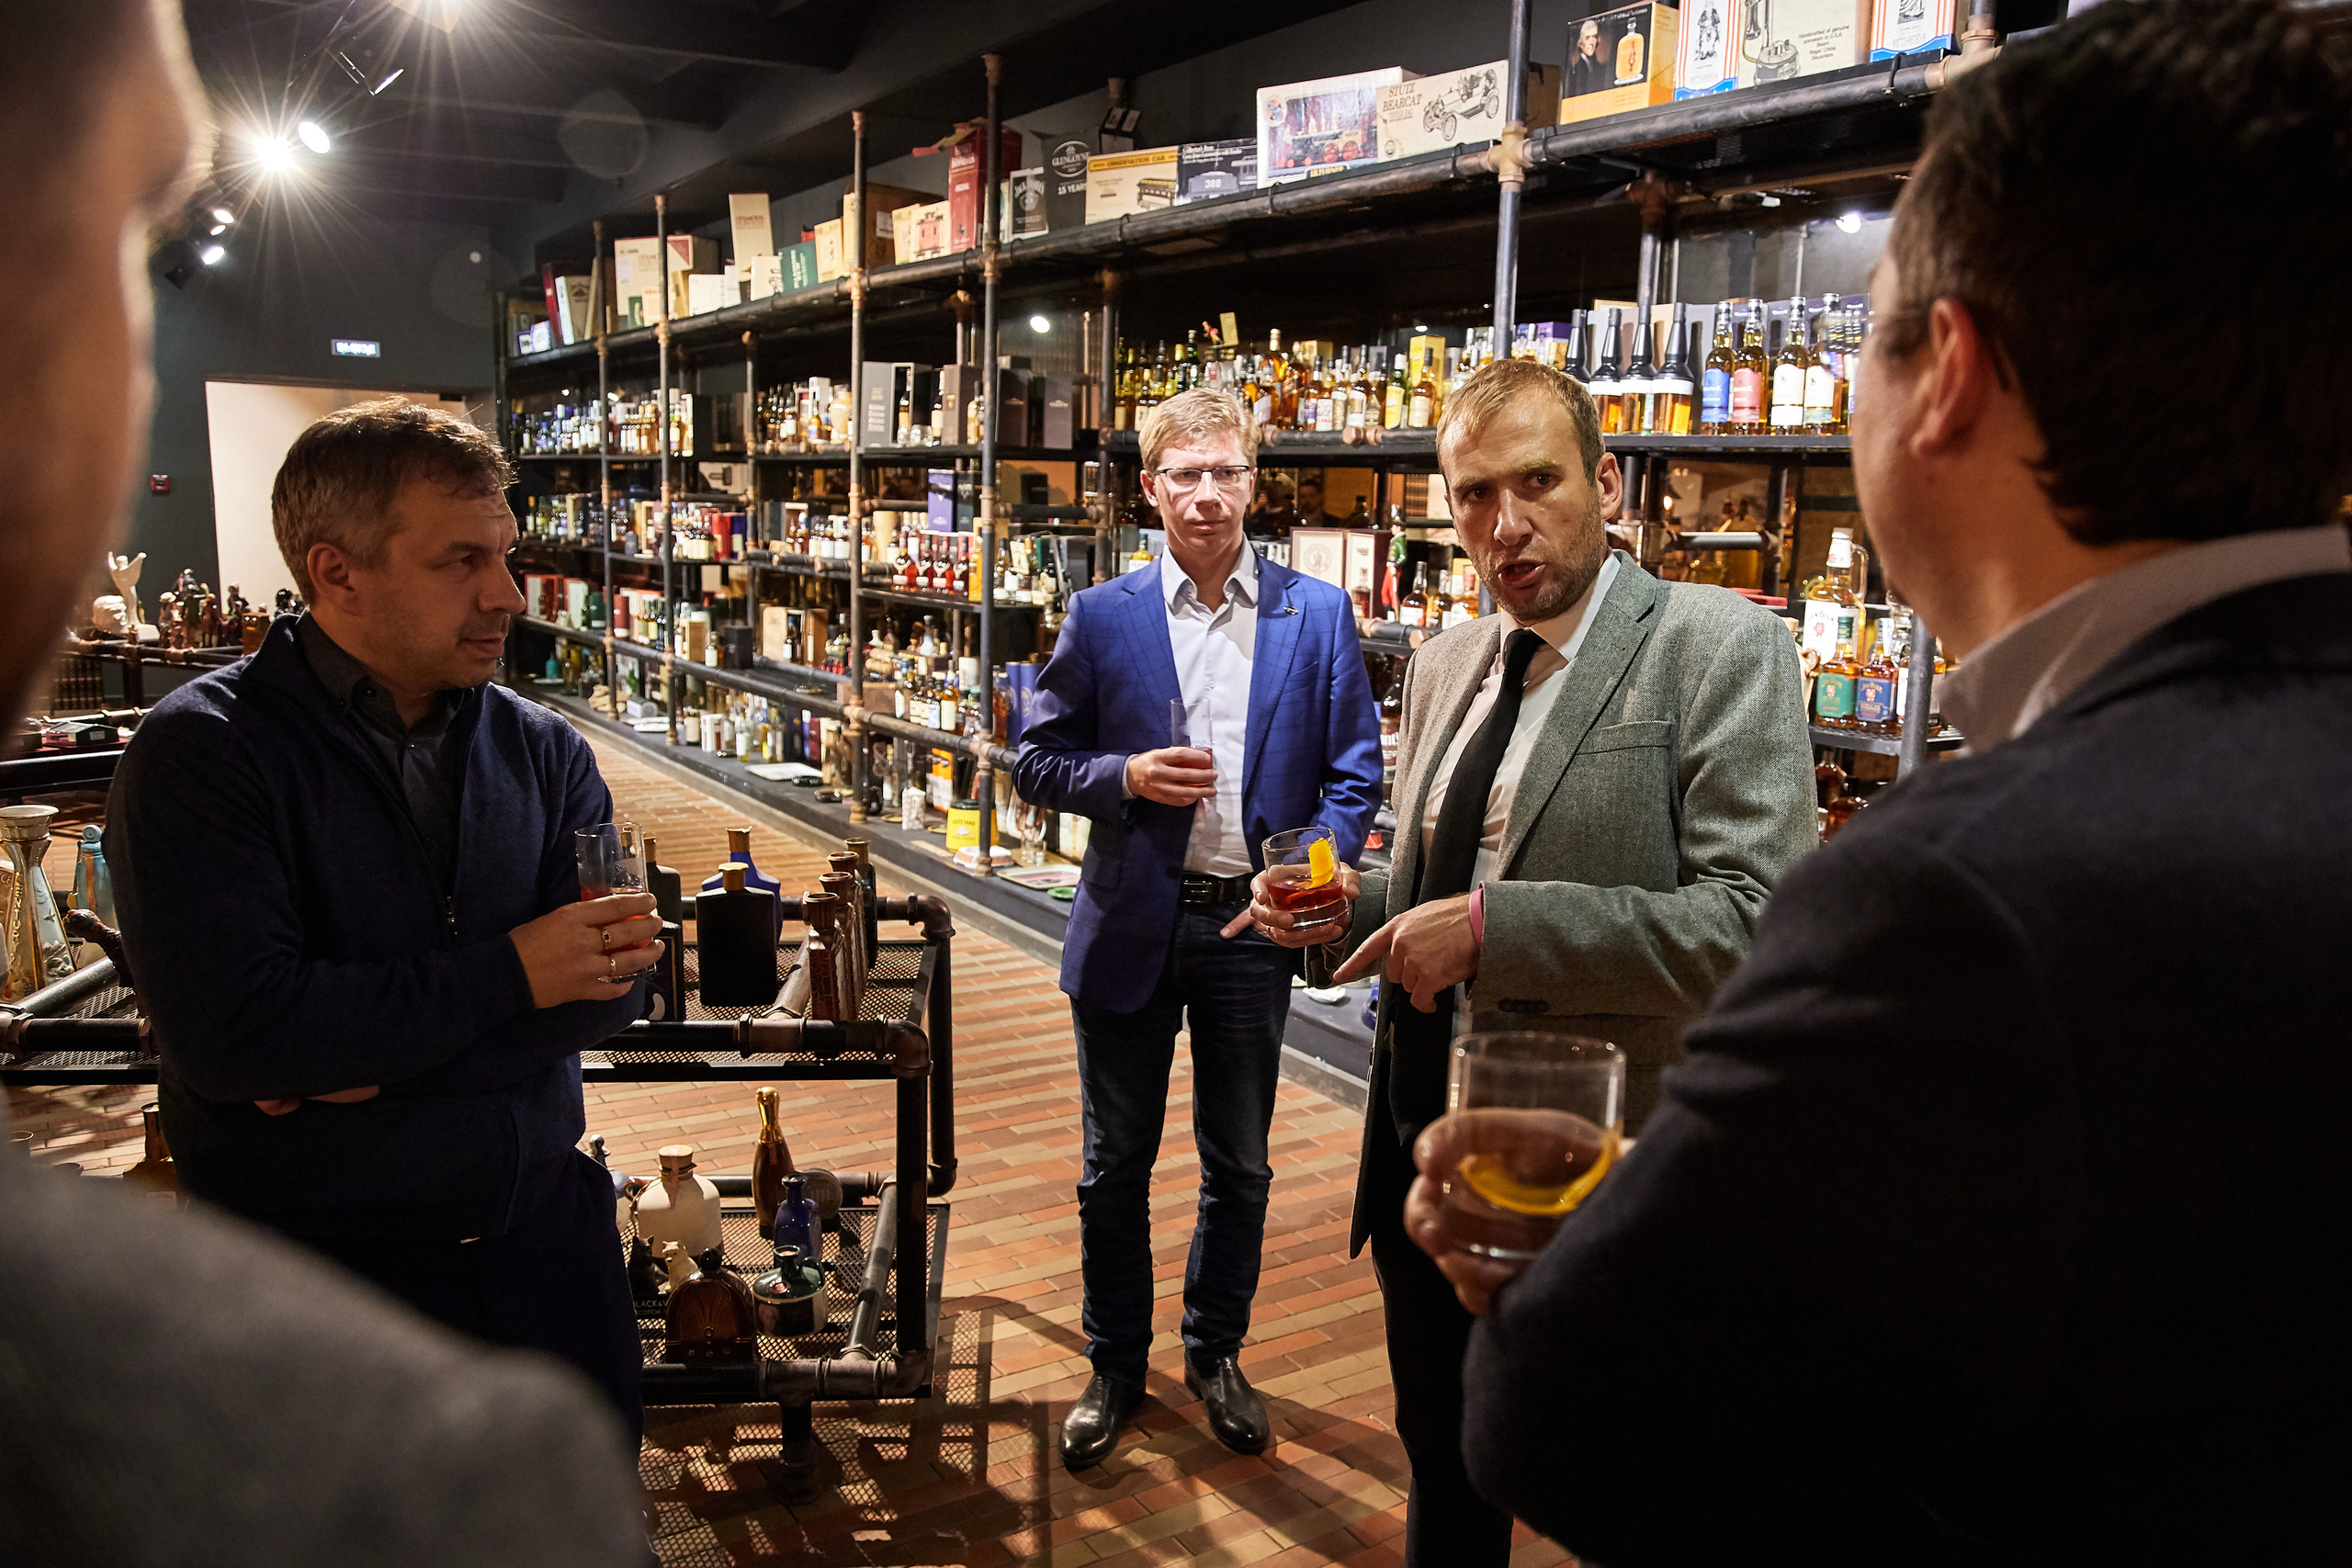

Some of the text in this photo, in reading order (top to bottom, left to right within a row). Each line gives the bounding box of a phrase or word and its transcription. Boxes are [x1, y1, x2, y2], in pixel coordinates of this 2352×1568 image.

[1388, 83, 1415, 97] STUTZ
[1383, 93, 1422, 111] BEARCAT
[1057, 186, 1067, 196] 15
